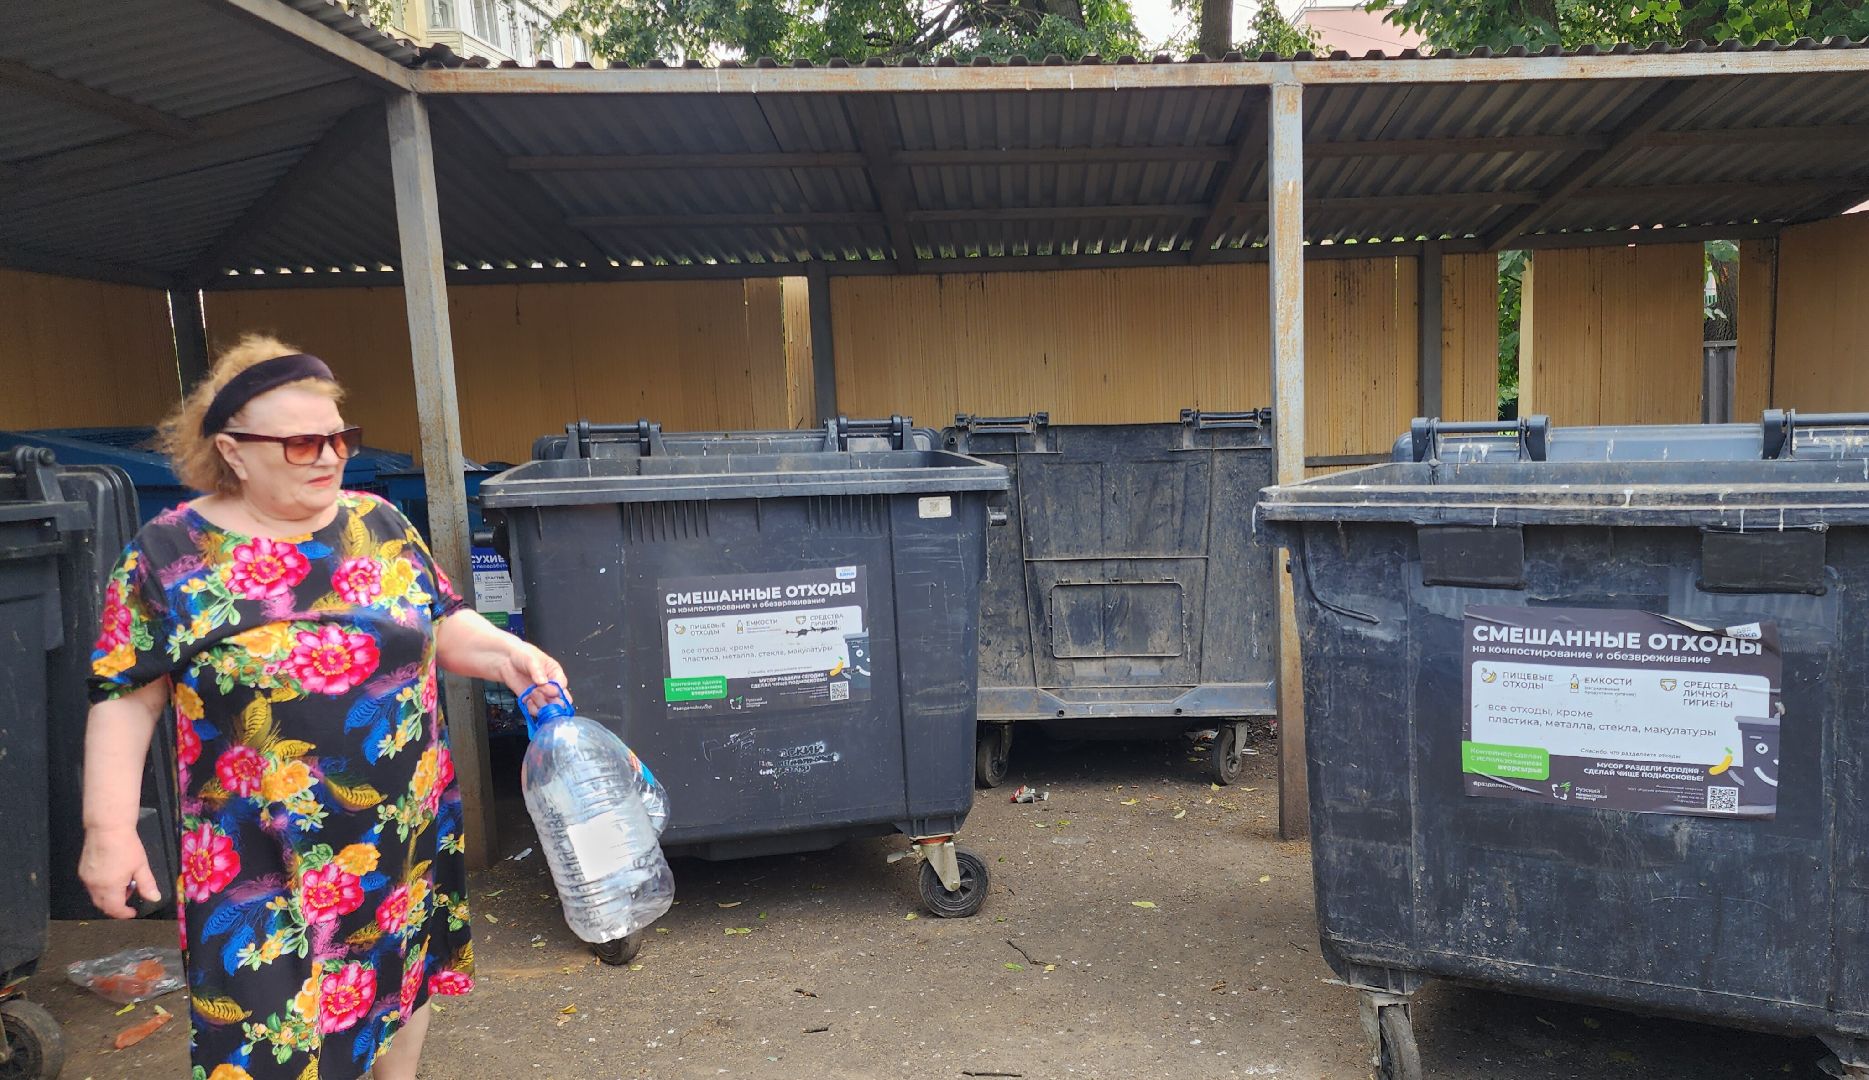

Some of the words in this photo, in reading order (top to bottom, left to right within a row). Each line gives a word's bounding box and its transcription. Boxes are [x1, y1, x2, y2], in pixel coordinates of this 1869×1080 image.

[666, 586, 781, 606] СМЕШАННЫЕ
[786, 581, 856, 598] ОТХОДЫ
[678, 603, 750, 613] компостирование
[760, 598, 826, 608] обезвреживание
[1472, 625, 1641, 649] СМЕШАННЫЕ
[1648, 633, 1762, 656] ОТХОДЫ
[682, 654, 720, 662] пластика,
[722, 652, 756, 660] металла,
[788, 646, 832, 654] макулатуры
[1472, 645, 1486, 653] на
[1488, 646, 1592, 659] компостирование
[1606, 651, 1711, 666] обезвреживание
[1502, 672, 1554, 682] ПИЩЕВЫЕ
[1584, 677, 1632, 686] ЕМКОСТИ
[1502, 680, 1544, 690] ОТХОДЫ
[1683, 680, 1738, 690] СРЕДСТВА
[1683, 690, 1728, 698] ЛИЧНОЙ
[1683, 698, 1733, 708] ГИГИЕНЫ
[1510, 706, 1554, 716] отходы,
[1556, 709, 1593, 719] кроме
[1488, 716, 1542, 726] пластика,
[1545, 720, 1596, 731] металла,
[1598, 723, 1641, 733] стекла,
[1644, 726, 1716, 737] макулатуры
[1584, 768, 1615, 776] СДЕЛАЙ
[1616, 770, 1640, 778] ЧИЩЕ
[1642, 772, 1704, 782] ПОДМОСКОВЬЕ!
[1625, 764, 1662, 772] РАЗДЕЛИ
[1662, 766, 1700, 774] СЕГОДНЯ
